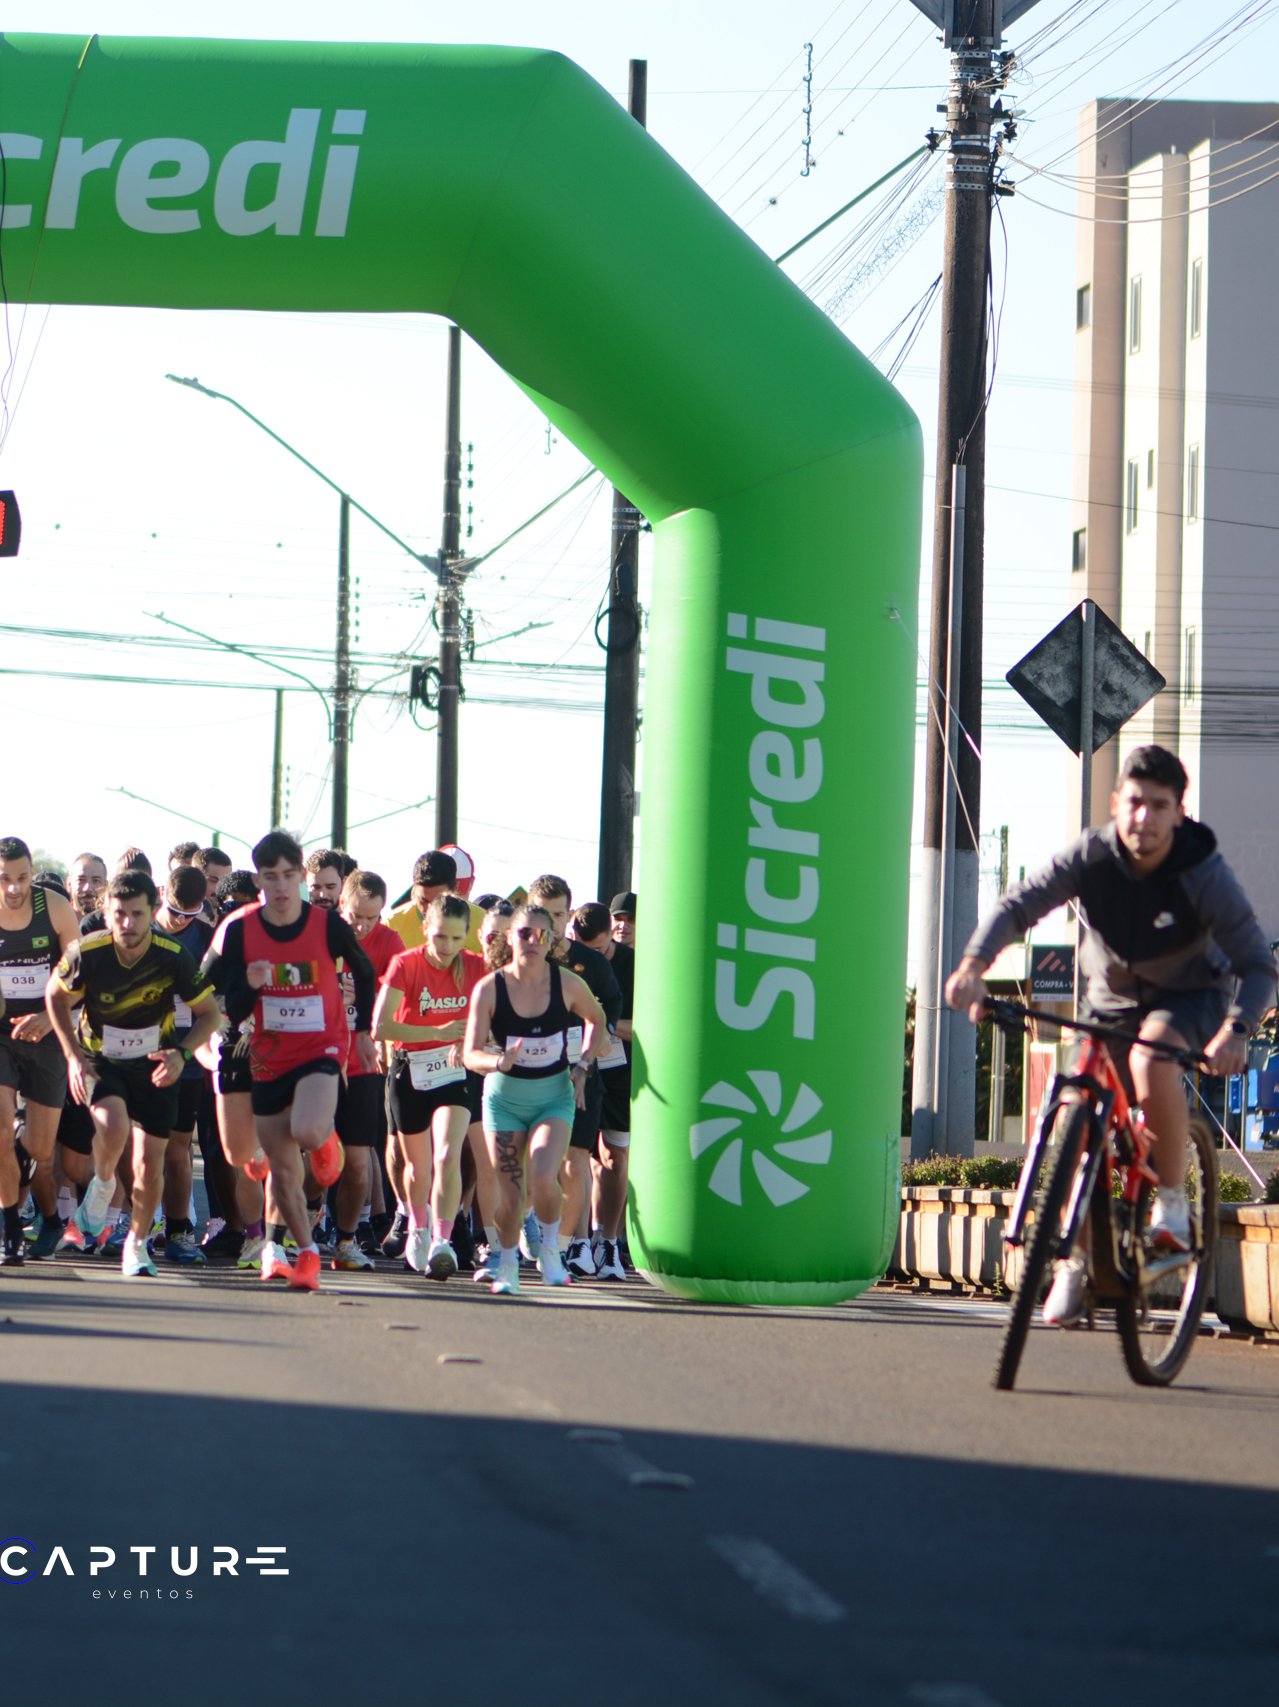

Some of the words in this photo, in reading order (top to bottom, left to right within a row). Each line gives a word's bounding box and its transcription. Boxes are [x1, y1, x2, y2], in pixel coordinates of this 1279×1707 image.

[715, 612, 826, 1041] Sicredi
[12, 976, 36, 985] 038
[1034, 980, 1064, 988] COMPRA
[427, 996, 467, 1009] AASLO
[279, 1008, 305, 1017] 072
[120, 1038, 143, 1047] 173
[426, 1060, 448, 1072] 201
